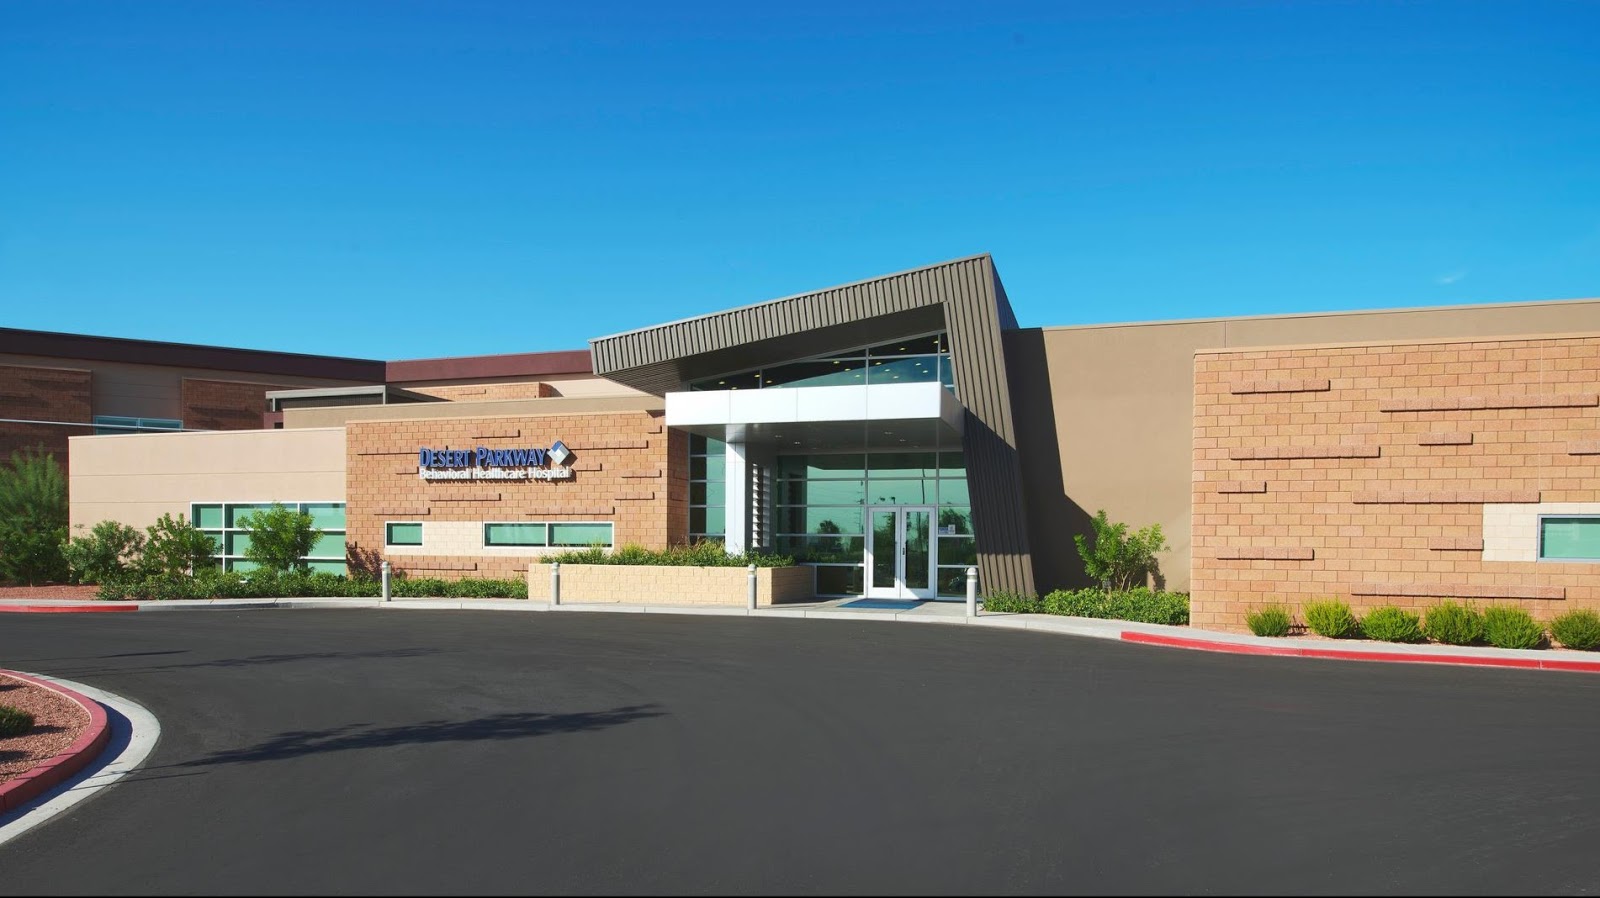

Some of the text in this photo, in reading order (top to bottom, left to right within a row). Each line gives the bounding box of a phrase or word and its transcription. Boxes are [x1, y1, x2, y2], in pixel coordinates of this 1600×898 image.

[420, 447, 546, 467] DESERT PARKWAY
[419, 466, 570, 481] Behavioral Healthcare Hospital
